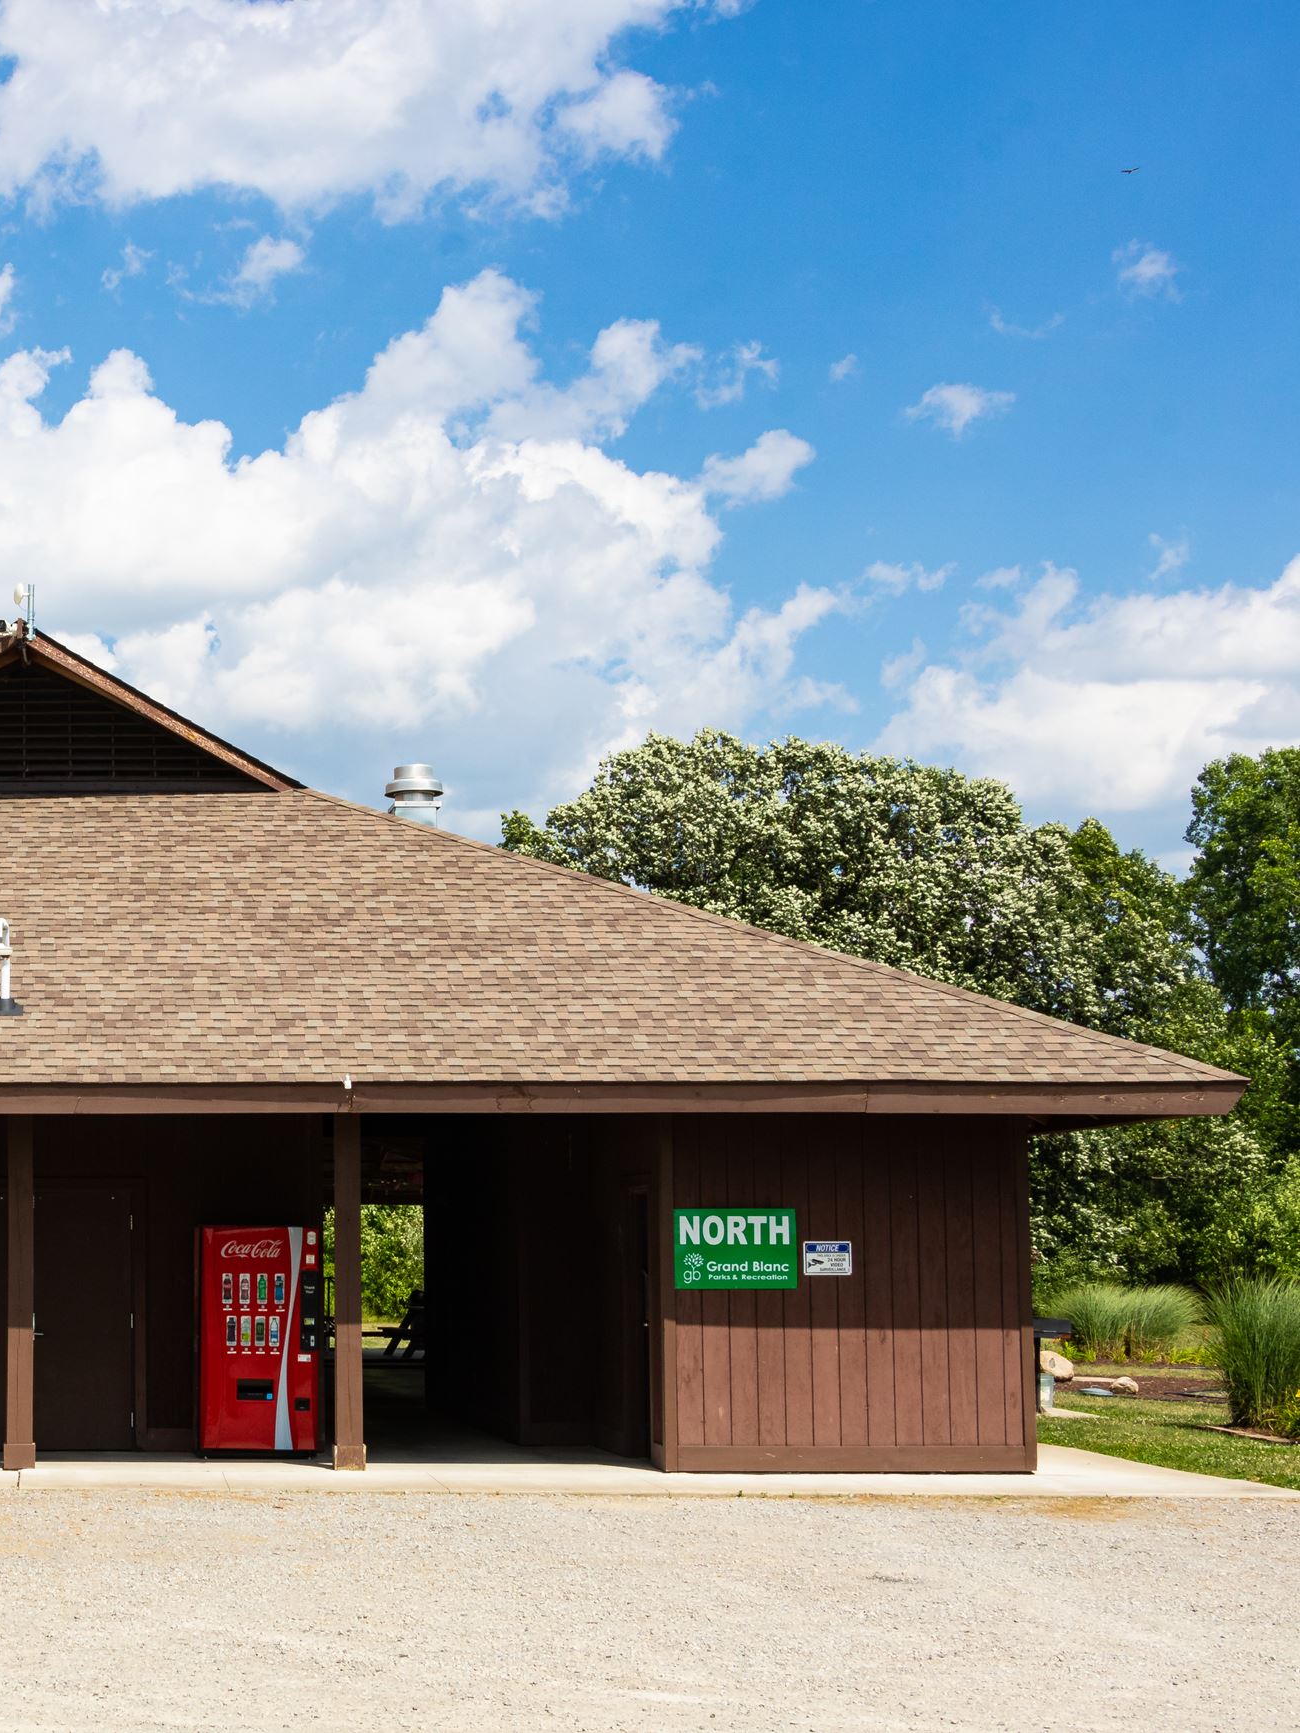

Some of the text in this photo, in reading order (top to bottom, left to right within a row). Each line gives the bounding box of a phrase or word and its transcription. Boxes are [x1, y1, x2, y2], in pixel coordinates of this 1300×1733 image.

[679, 1215, 790, 1246] NORTH
[220, 1240, 284, 1259] Coca-Cola
[815, 1244, 840, 1252] NOTICE
[706, 1261, 789, 1272] Grand Blanc
[683, 1270, 701, 1284] gb
